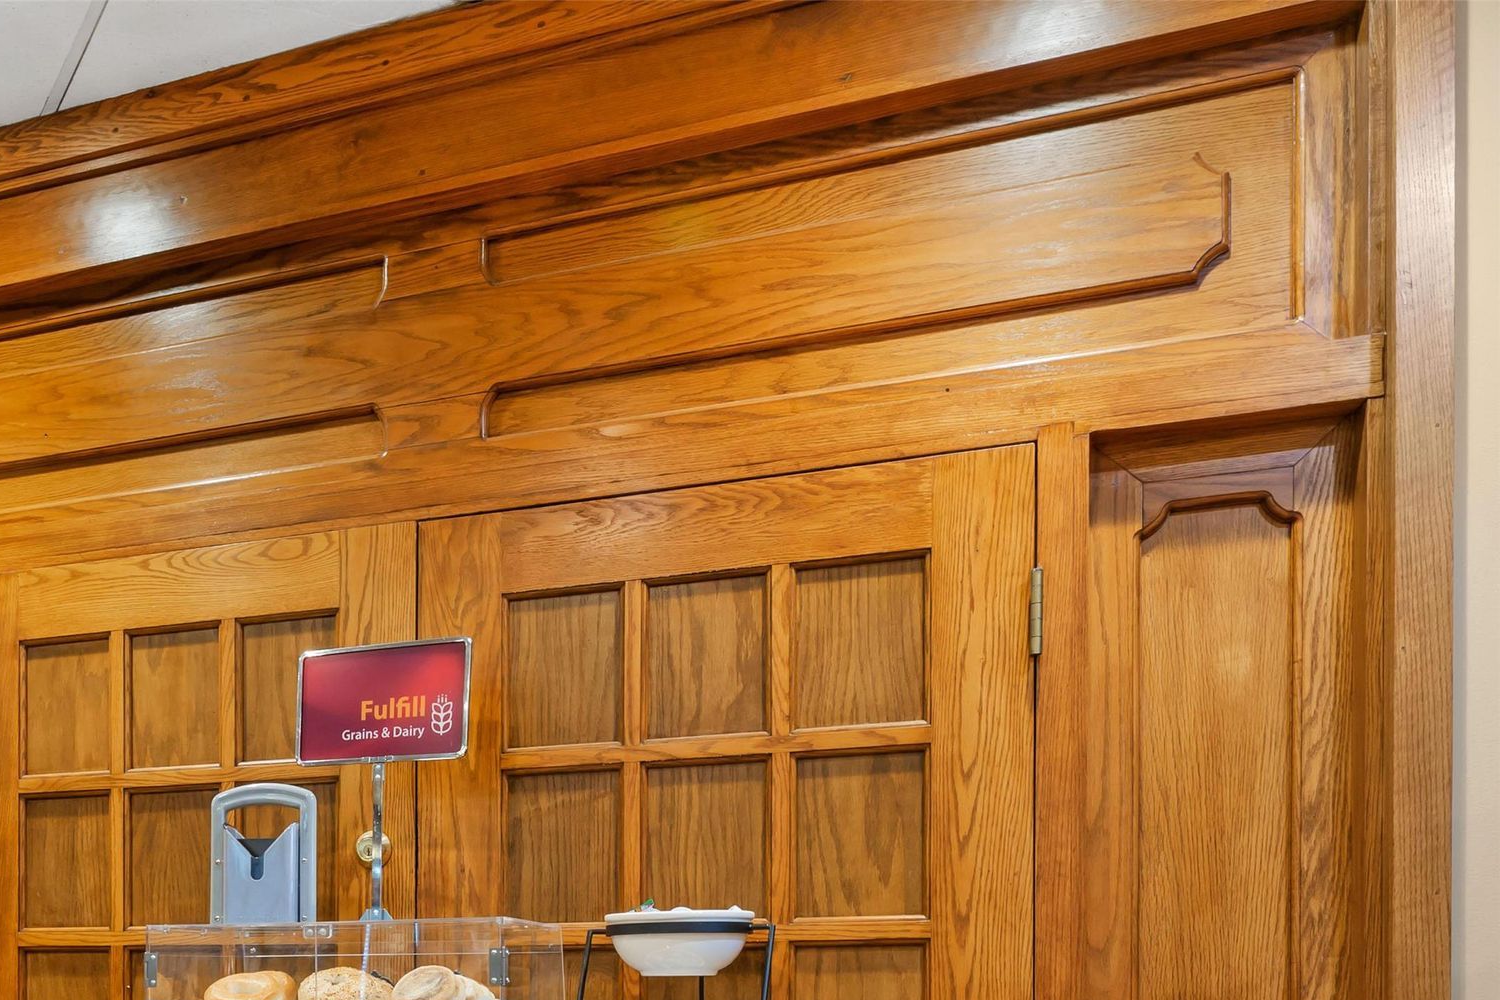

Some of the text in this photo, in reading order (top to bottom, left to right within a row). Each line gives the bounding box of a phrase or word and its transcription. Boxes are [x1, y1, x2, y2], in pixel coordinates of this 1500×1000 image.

[360, 695, 426, 721] Fulfill
[341, 724, 425, 741] Grains & Dairy
